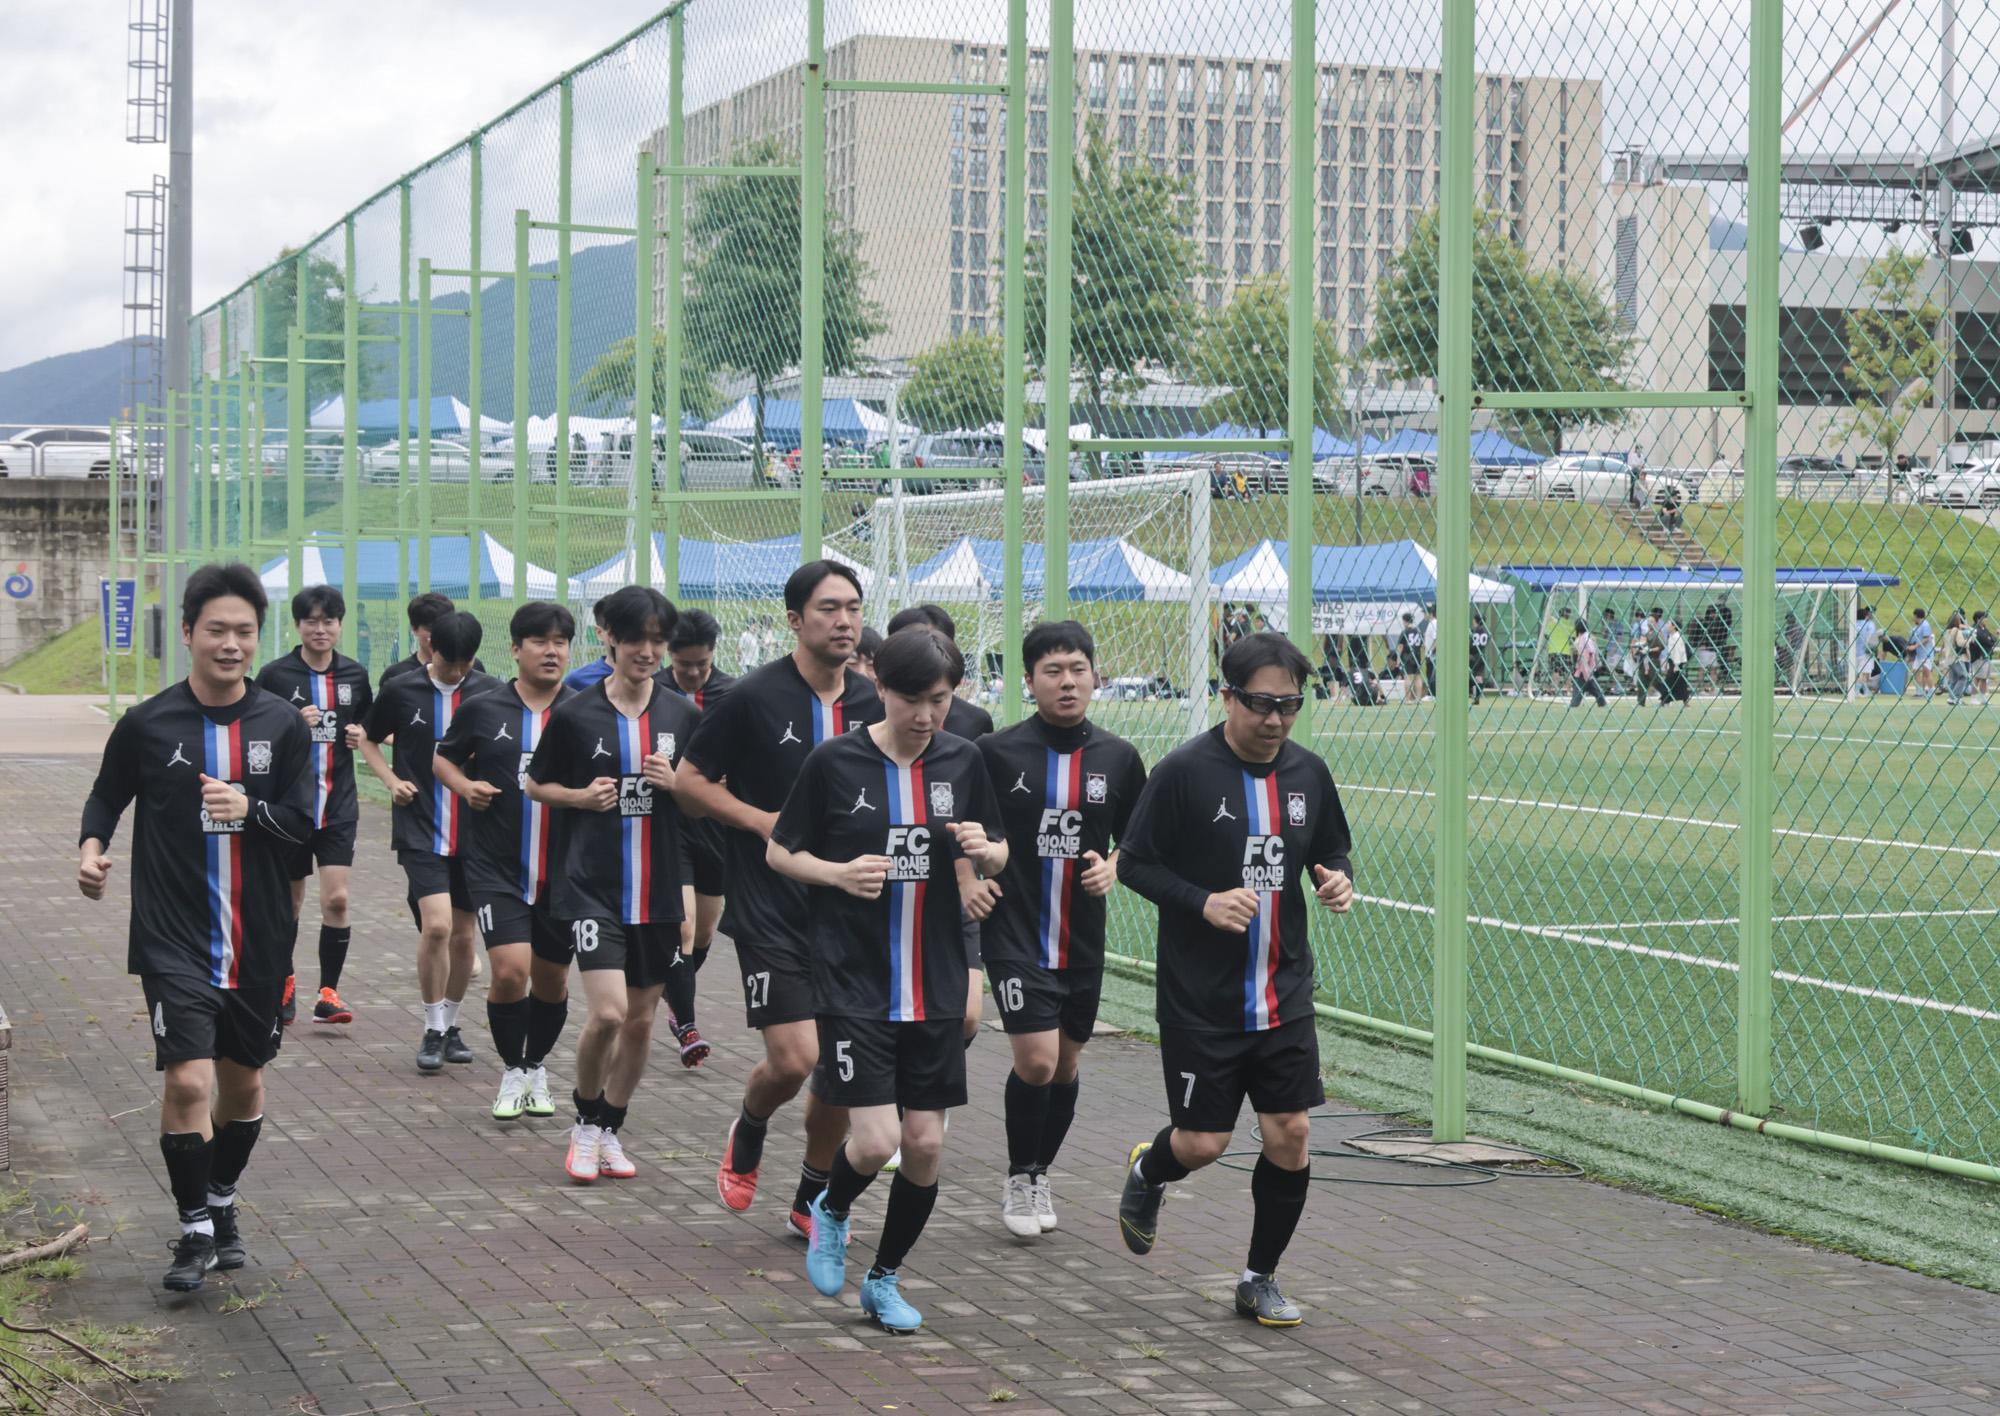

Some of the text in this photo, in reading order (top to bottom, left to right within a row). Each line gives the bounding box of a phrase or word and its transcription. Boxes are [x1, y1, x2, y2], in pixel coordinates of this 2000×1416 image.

[1472, 633, 1488, 646] 20
[1353, 672, 1363, 684] 3
[620, 776, 652, 797] FC
[619, 797, 653, 815] 일요신문
[1038, 808, 1083, 836] FC
[885, 827, 931, 855] FC
[1036, 834, 1080, 859] 일요신문
[1243, 835, 1285, 866] FC
[1241, 865, 1284, 891] 일요신문
[478, 903, 494, 934] 11
[571, 918, 599, 953] 18
[746, 971, 770, 1008] 27
[998, 977, 1024, 1013] 16
[153, 1001, 167, 1037] 4
[836, 1040, 854, 1082] 5
[1180, 1071, 1196, 1108] 7
